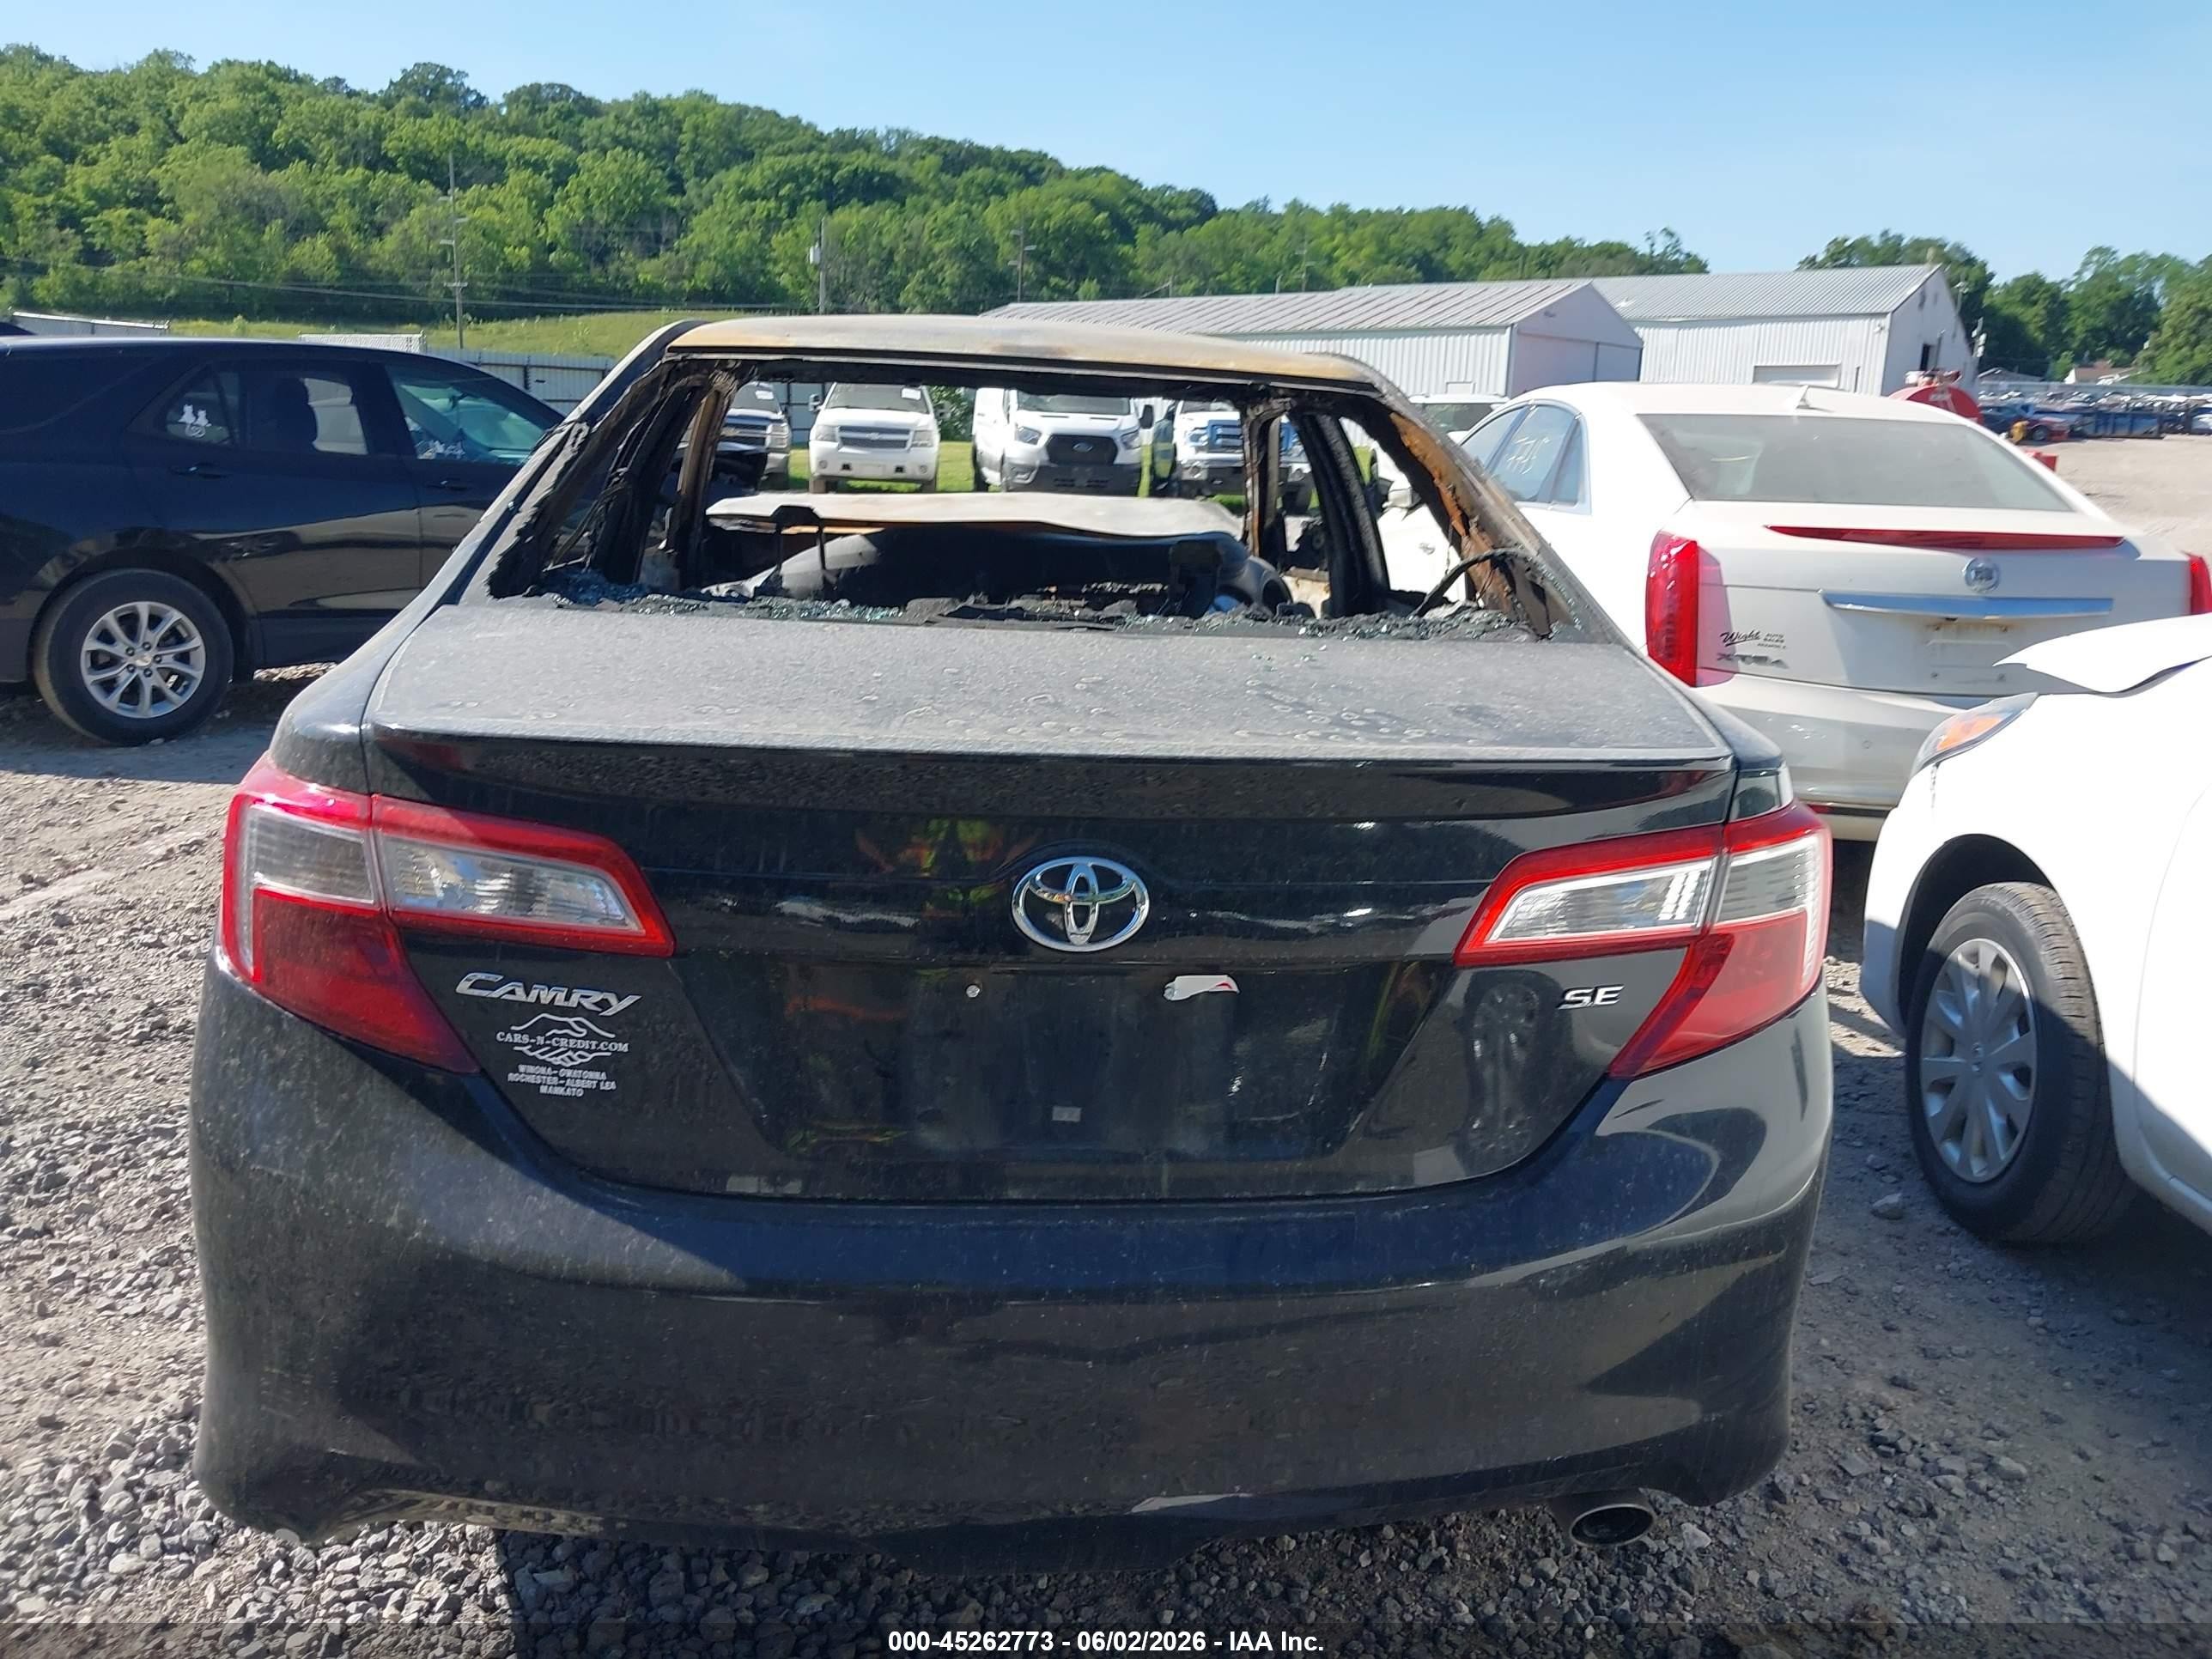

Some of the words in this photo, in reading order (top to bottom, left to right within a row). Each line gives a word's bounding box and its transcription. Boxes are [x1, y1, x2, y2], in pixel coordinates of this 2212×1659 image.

[456, 972, 642, 1016] CAMRY
[1558, 984, 1625, 1010] SE
[495, 1030, 629, 1053] CARS-N-CREDIT.COM
